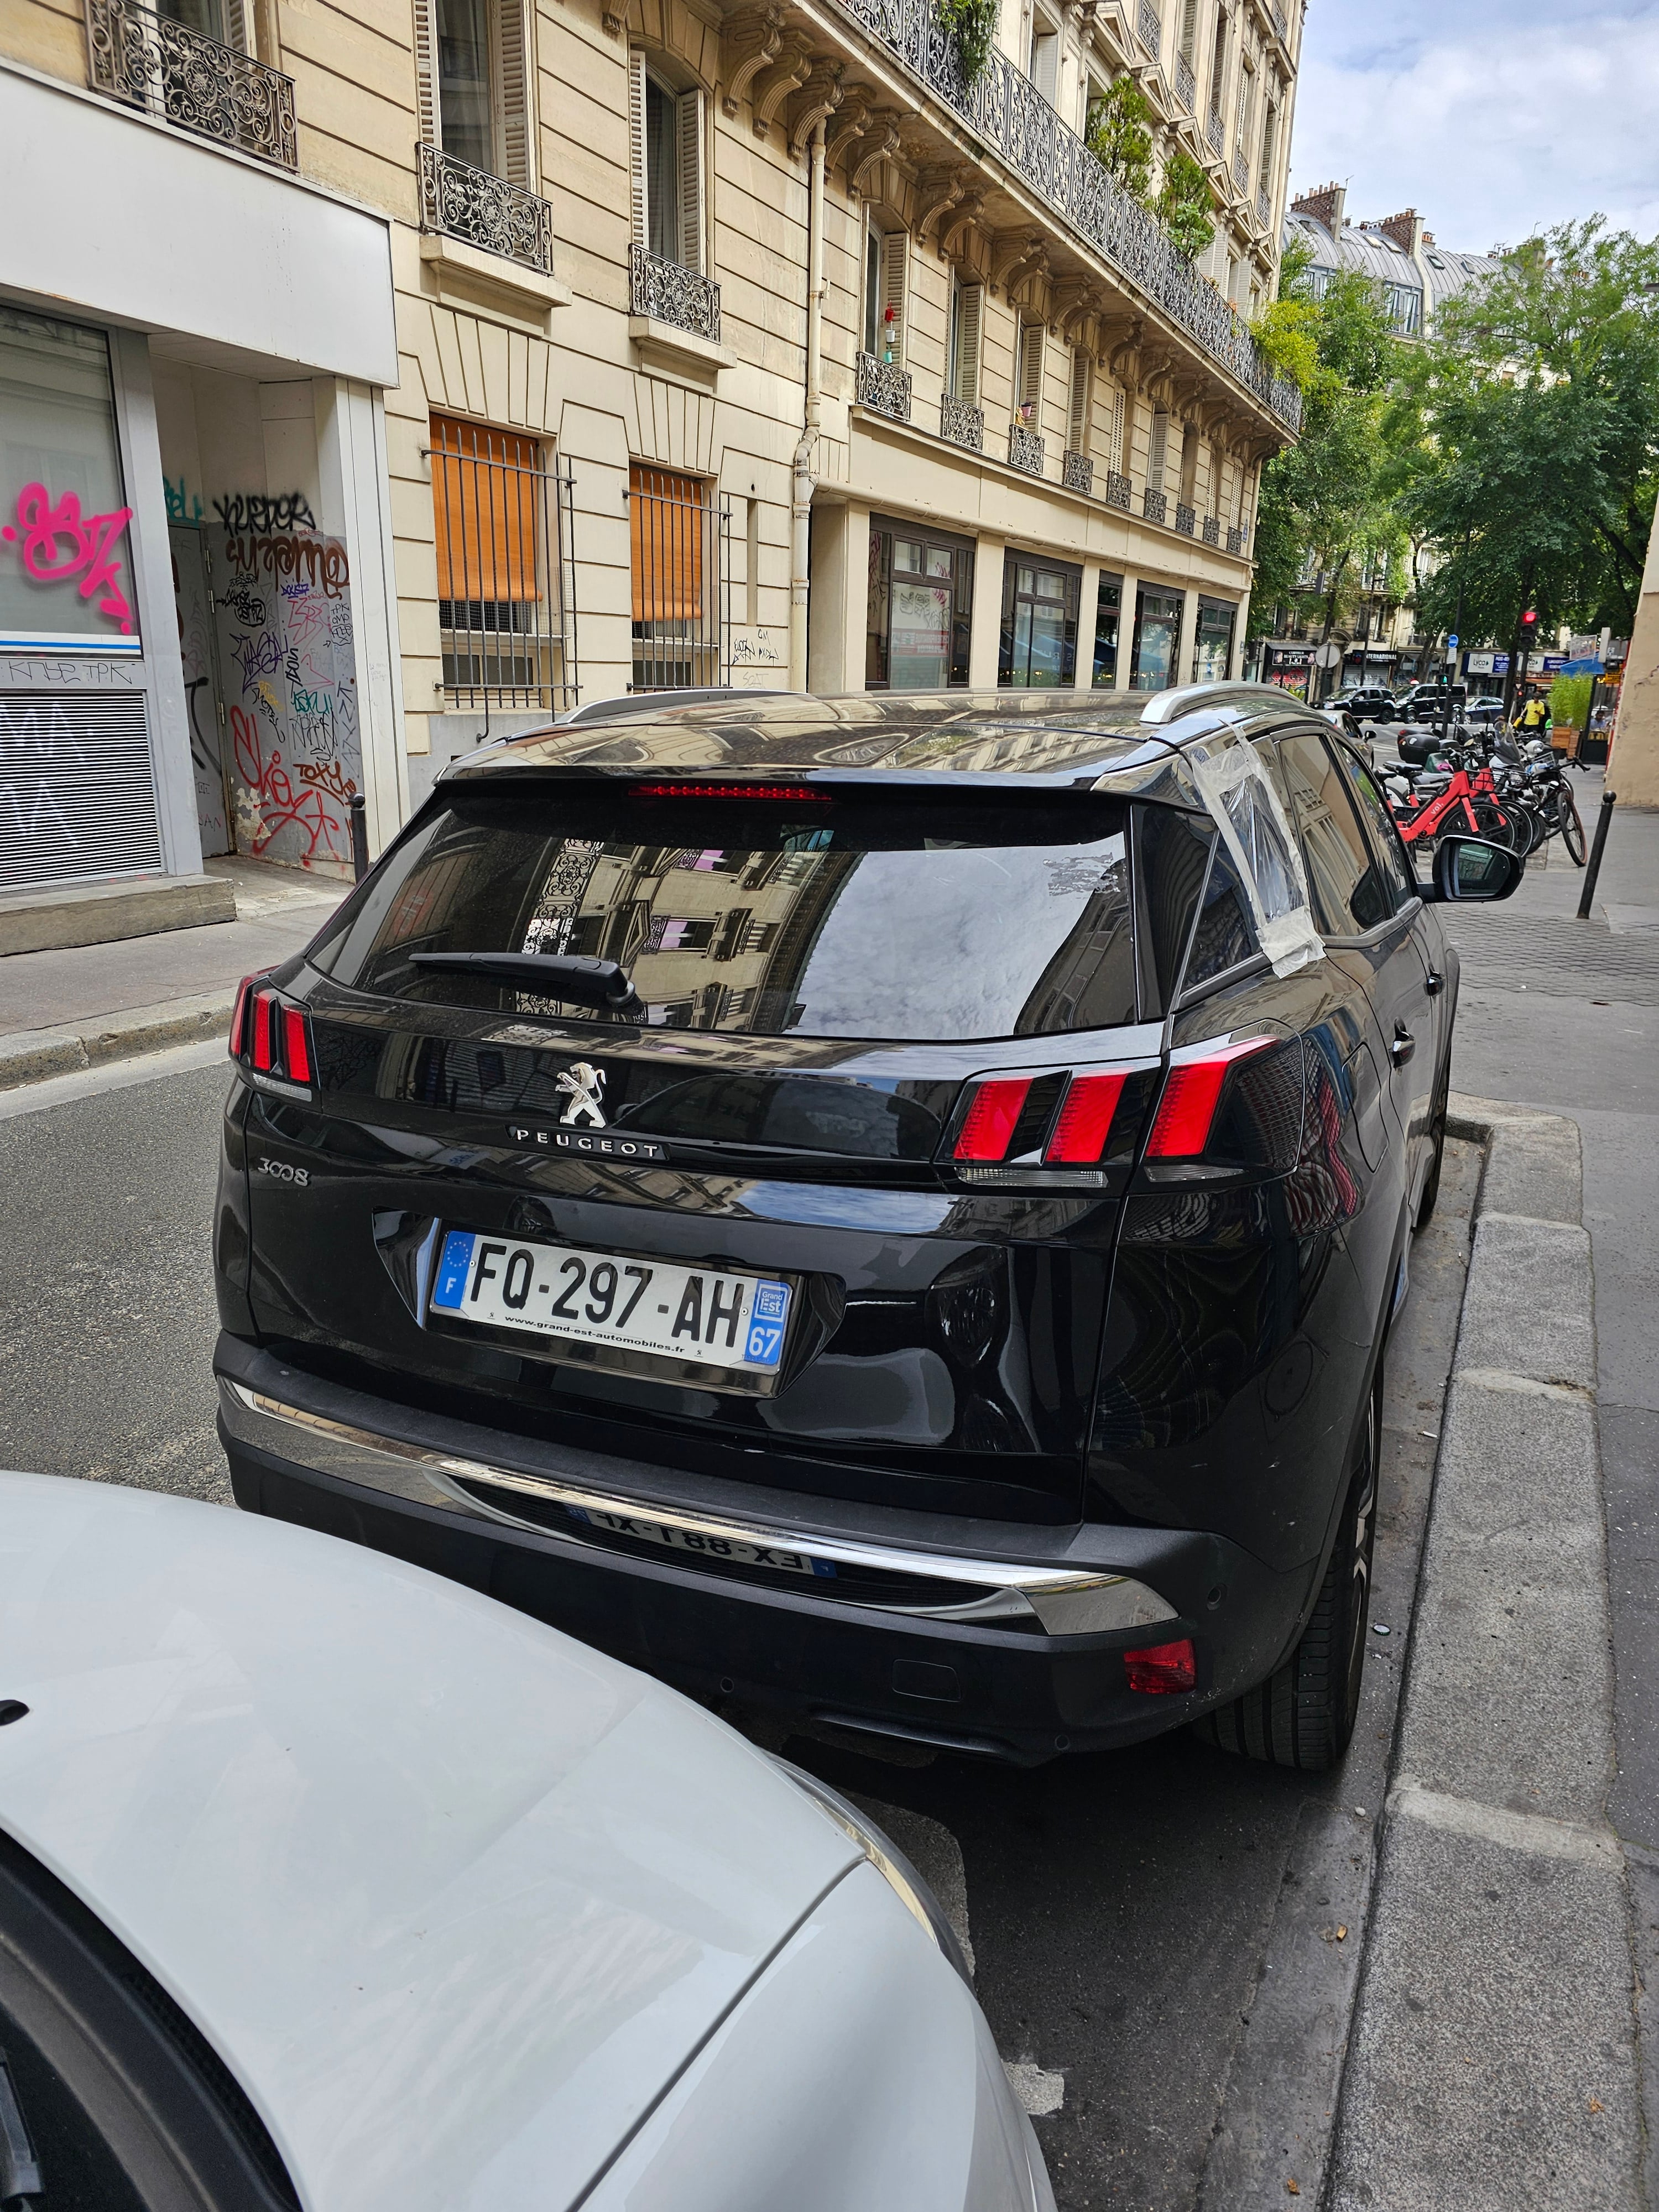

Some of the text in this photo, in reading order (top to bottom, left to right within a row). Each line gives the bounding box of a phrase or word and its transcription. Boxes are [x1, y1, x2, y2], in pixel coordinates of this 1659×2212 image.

[515, 1129, 659, 1159] PEUGEOT
[257, 1157, 309, 1187] 3008
[445, 1276, 457, 1294] F
[470, 1242, 745, 1348] FQ-297-AH
[761, 1291, 784, 1301] Grand
[759, 1297, 781, 1313] Est
[504, 1316, 686, 1353] www.grand-est-automobiles.fr
[748, 1326, 781, 1358] 67
